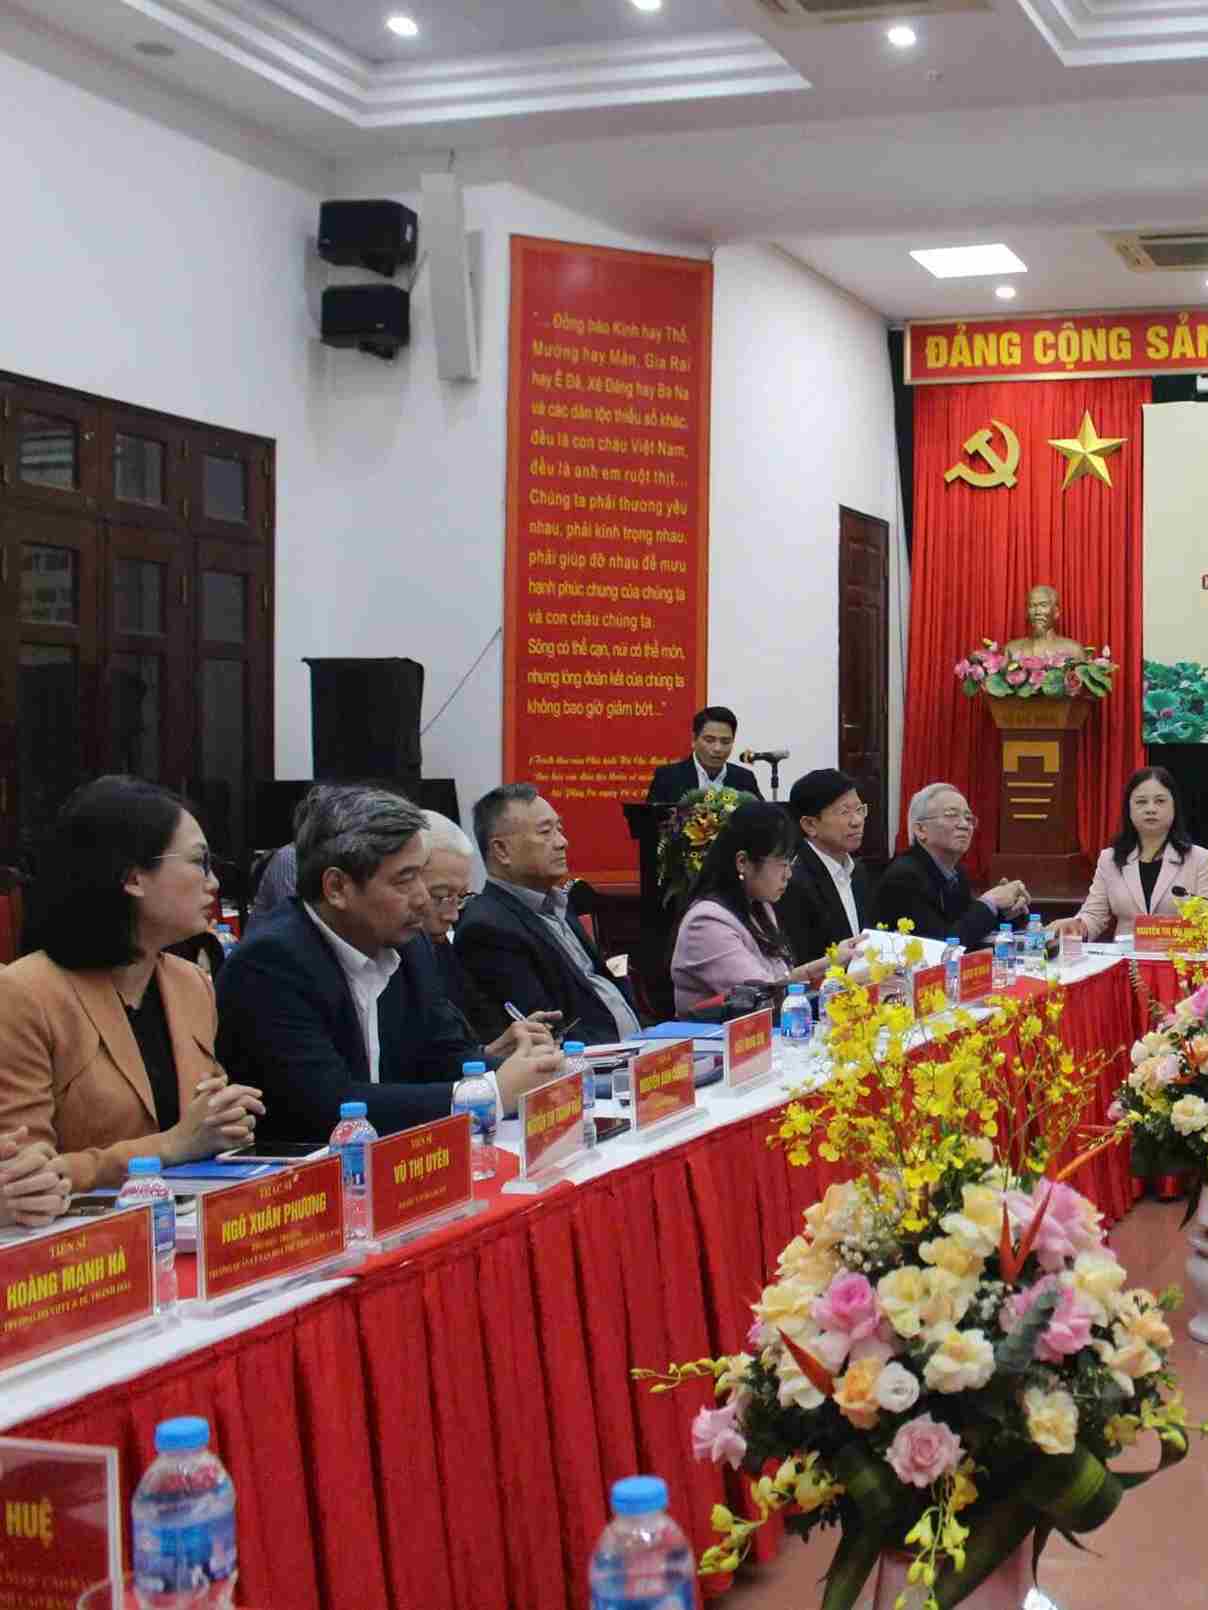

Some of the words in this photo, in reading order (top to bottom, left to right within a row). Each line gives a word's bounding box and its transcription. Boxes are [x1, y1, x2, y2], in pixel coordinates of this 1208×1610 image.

[925, 322, 1021, 368] ĐẢNG
[1033, 323, 1131, 370] CỘNG
[222, 1213, 247, 1245] NGÔ
[249, 1203, 281, 1236] XUÂN
[7, 1272, 58, 1311] HOÀNG
[62, 1255, 105, 1292] MẠNH
